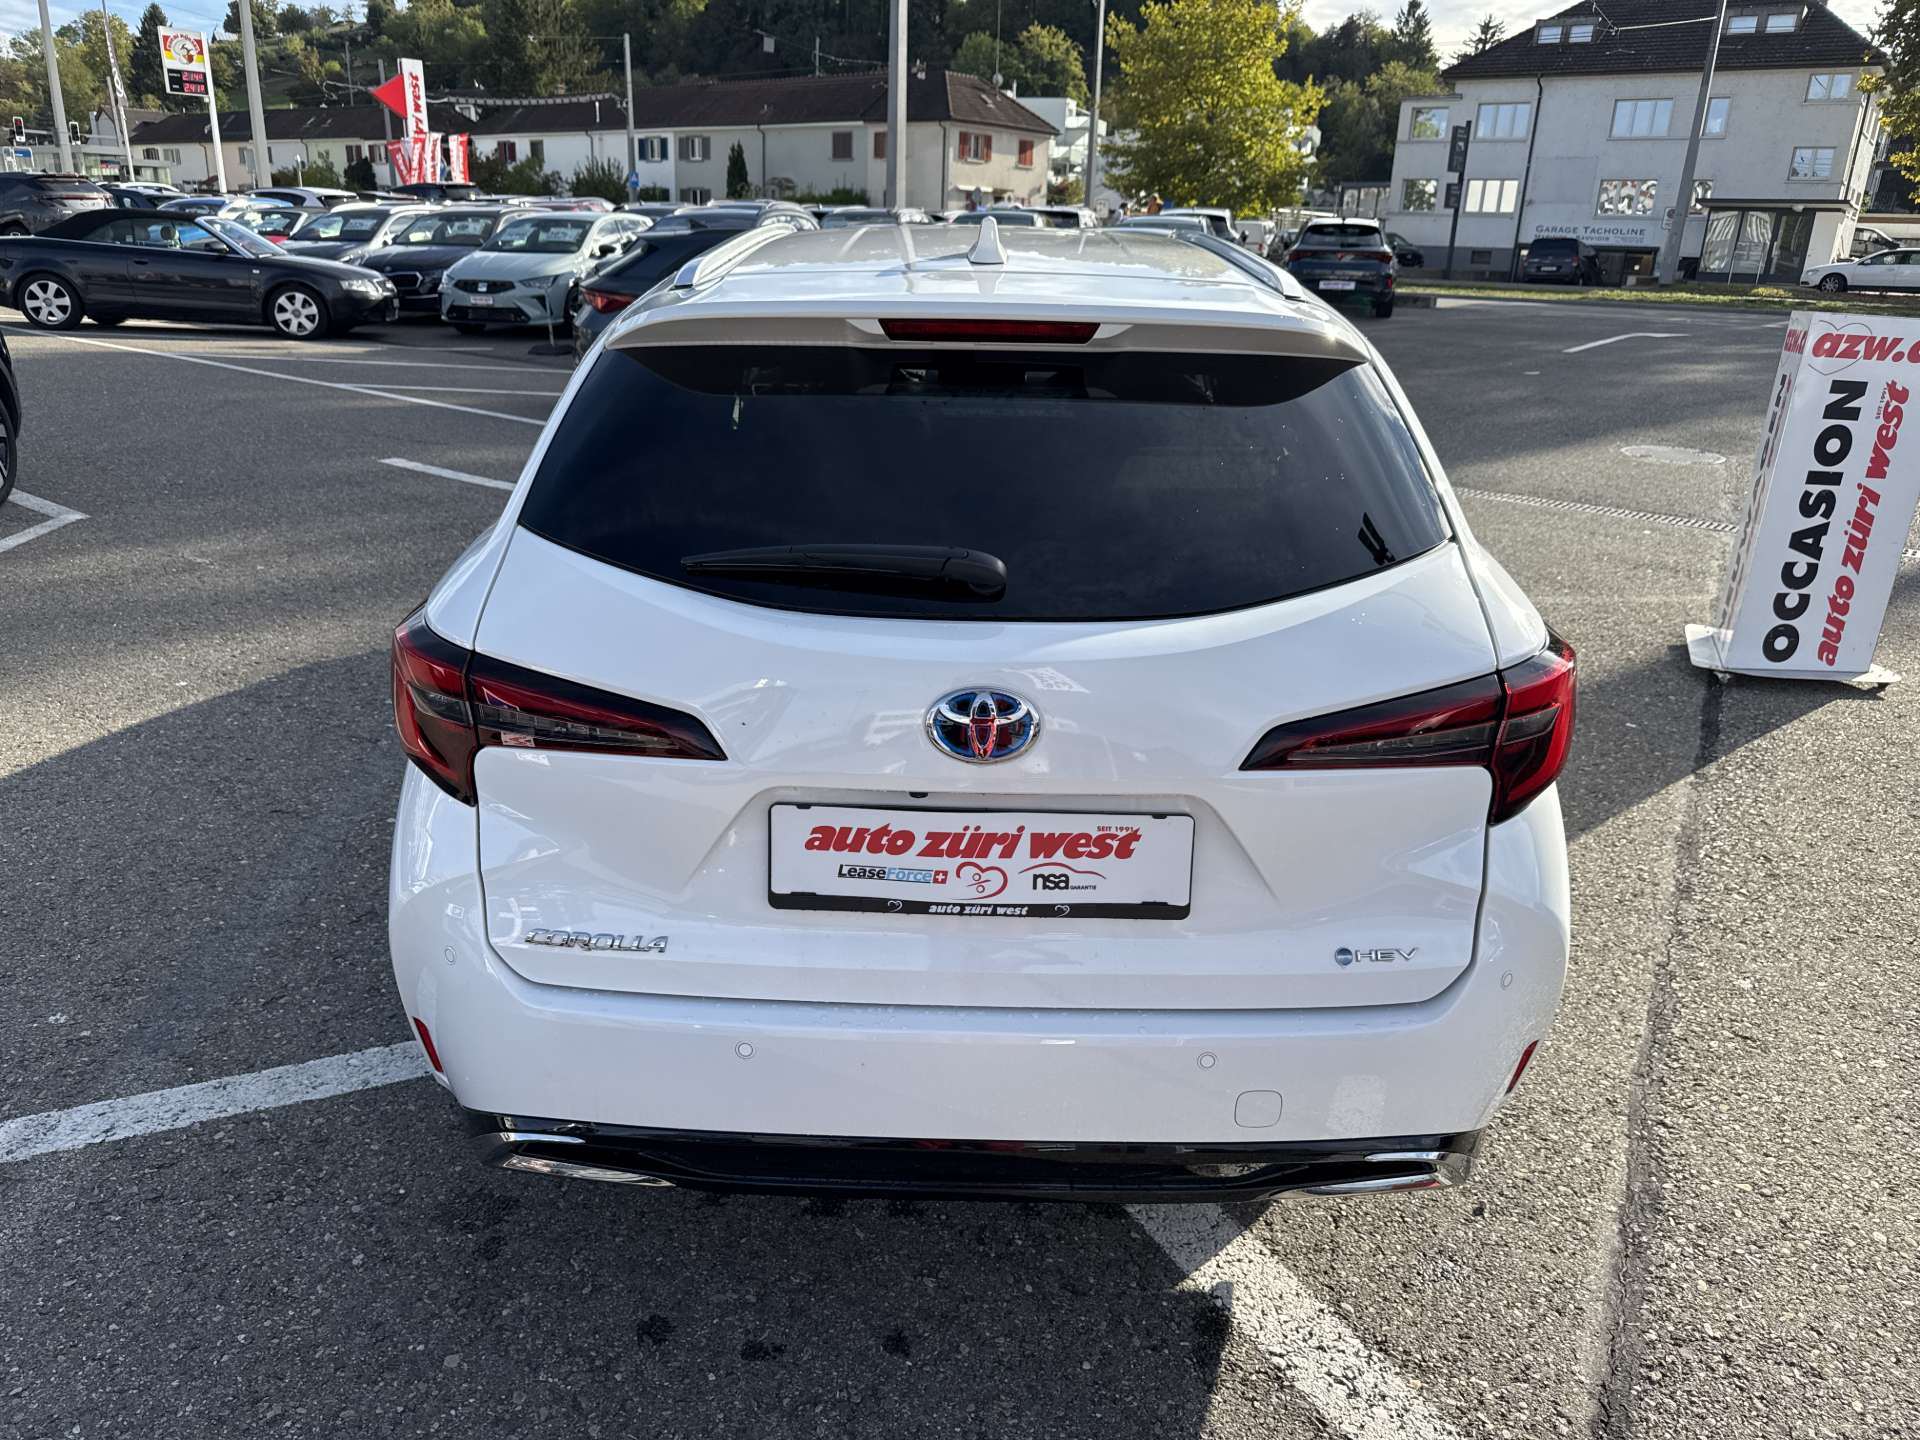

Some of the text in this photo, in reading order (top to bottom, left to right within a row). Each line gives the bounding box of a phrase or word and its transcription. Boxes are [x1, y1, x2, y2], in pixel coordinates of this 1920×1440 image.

[409, 72, 421, 113] west
[1535, 225, 1647, 236] GARAGE TACHOLINE
[1762, 379, 1869, 663] OCCASION
[1817, 379, 1910, 667] auto züri west
[804, 823, 1143, 860] auto züri west
[837, 864, 933, 883] LeaseForce
[1032, 873, 1070, 890] nsa
[928, 903, 1029, 916] auto züri west
[525, 928, 669, 953] COROLLA
[1355, 947, 1419, 962] HEV
